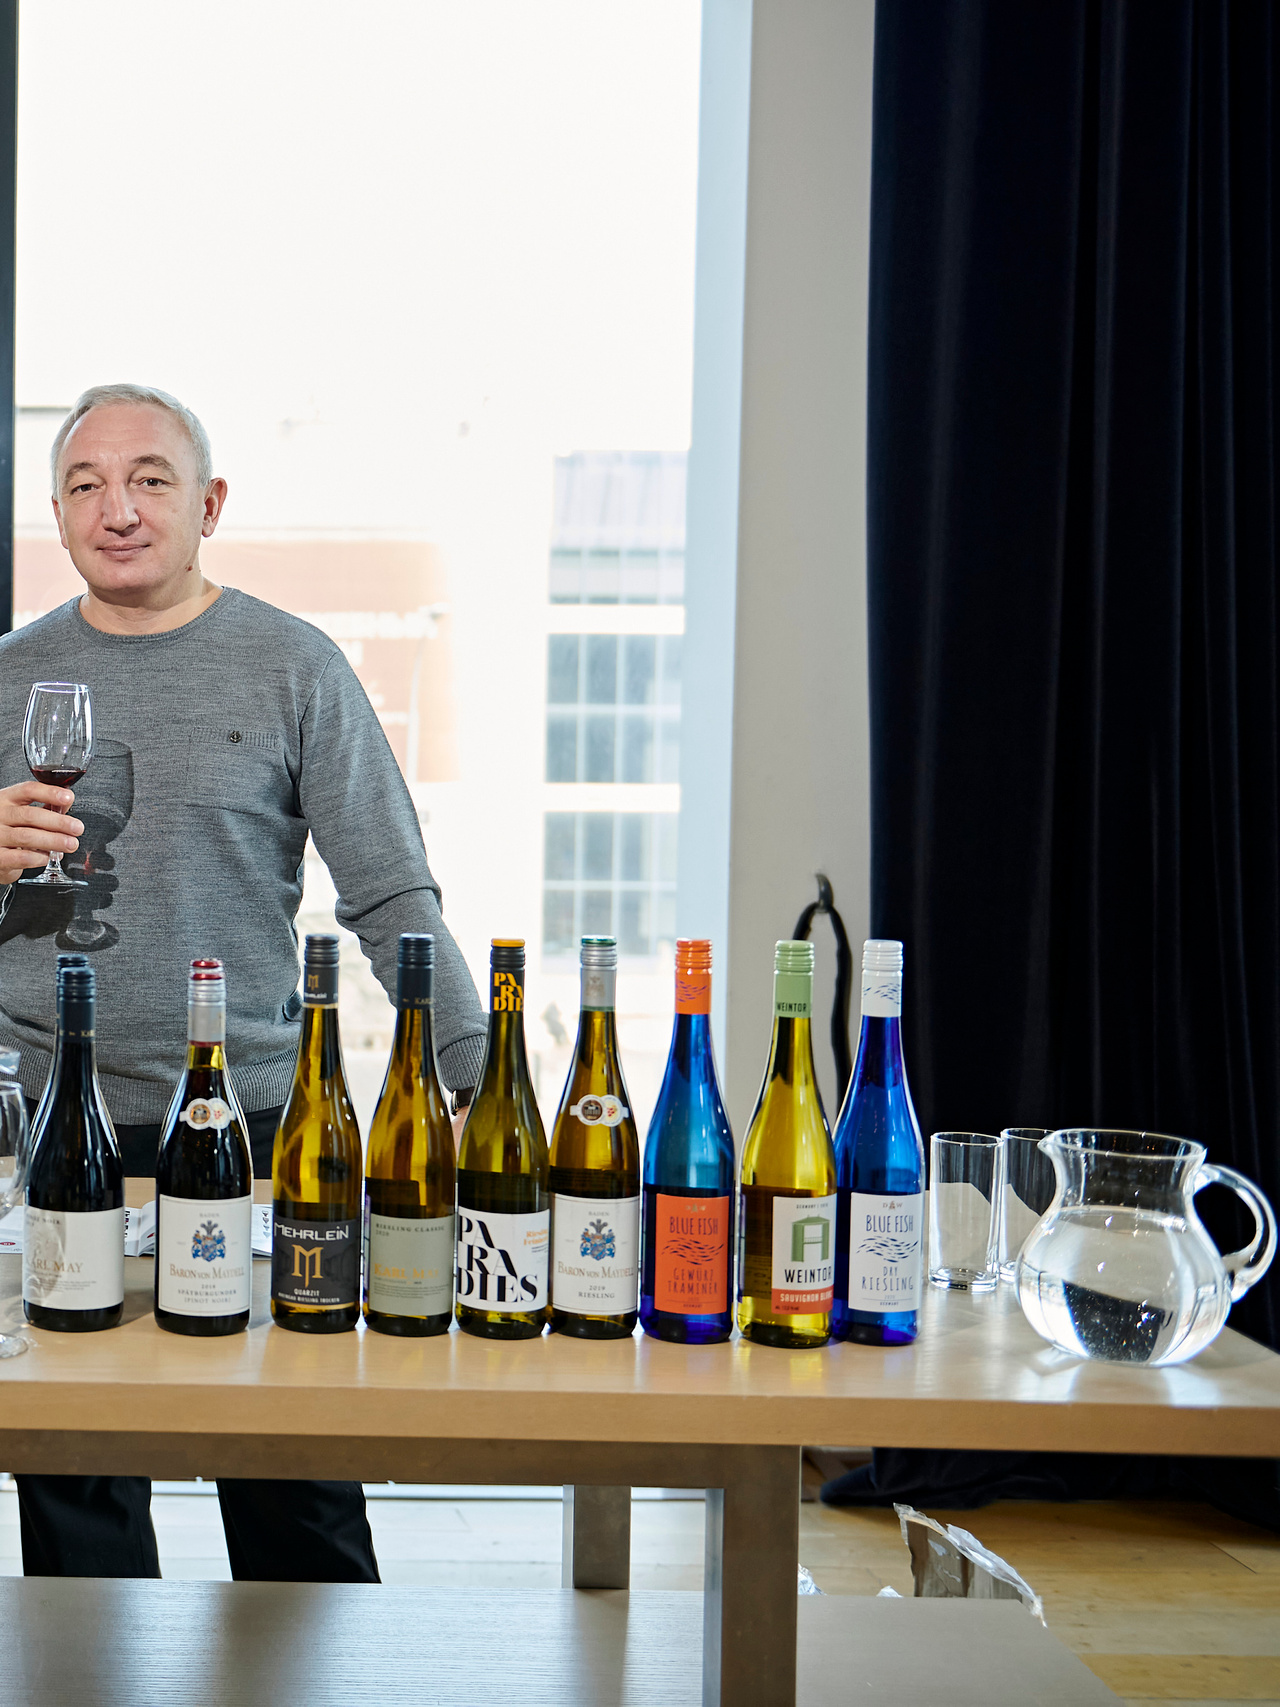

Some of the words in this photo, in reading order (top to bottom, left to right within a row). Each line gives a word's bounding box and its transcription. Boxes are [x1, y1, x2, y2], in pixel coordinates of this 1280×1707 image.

[376, 1223, 412, 1232] RIESLING
[669, 1216, 694, 1235] BLUE
[698, 1217, 719, 1235] FISH
[866, 1214, 891, 1233] BLUE
[895, 1215, 914, 1232] FISH
[53, 1260, 84, 1273] MAY
[374, 1263, 408, 1279] KARL
[883, 1266, 898, 1277] DRY
[784, 1266, 832, 1284] WEINTOR
[667, 1280, 718, 1294] TRAMINER
[862, 1276, 914, 1291] RIESLING
[578, 1291, 616, 1299] RIESLING
[780, 1293, 819, 1303] SAUVIGNON
